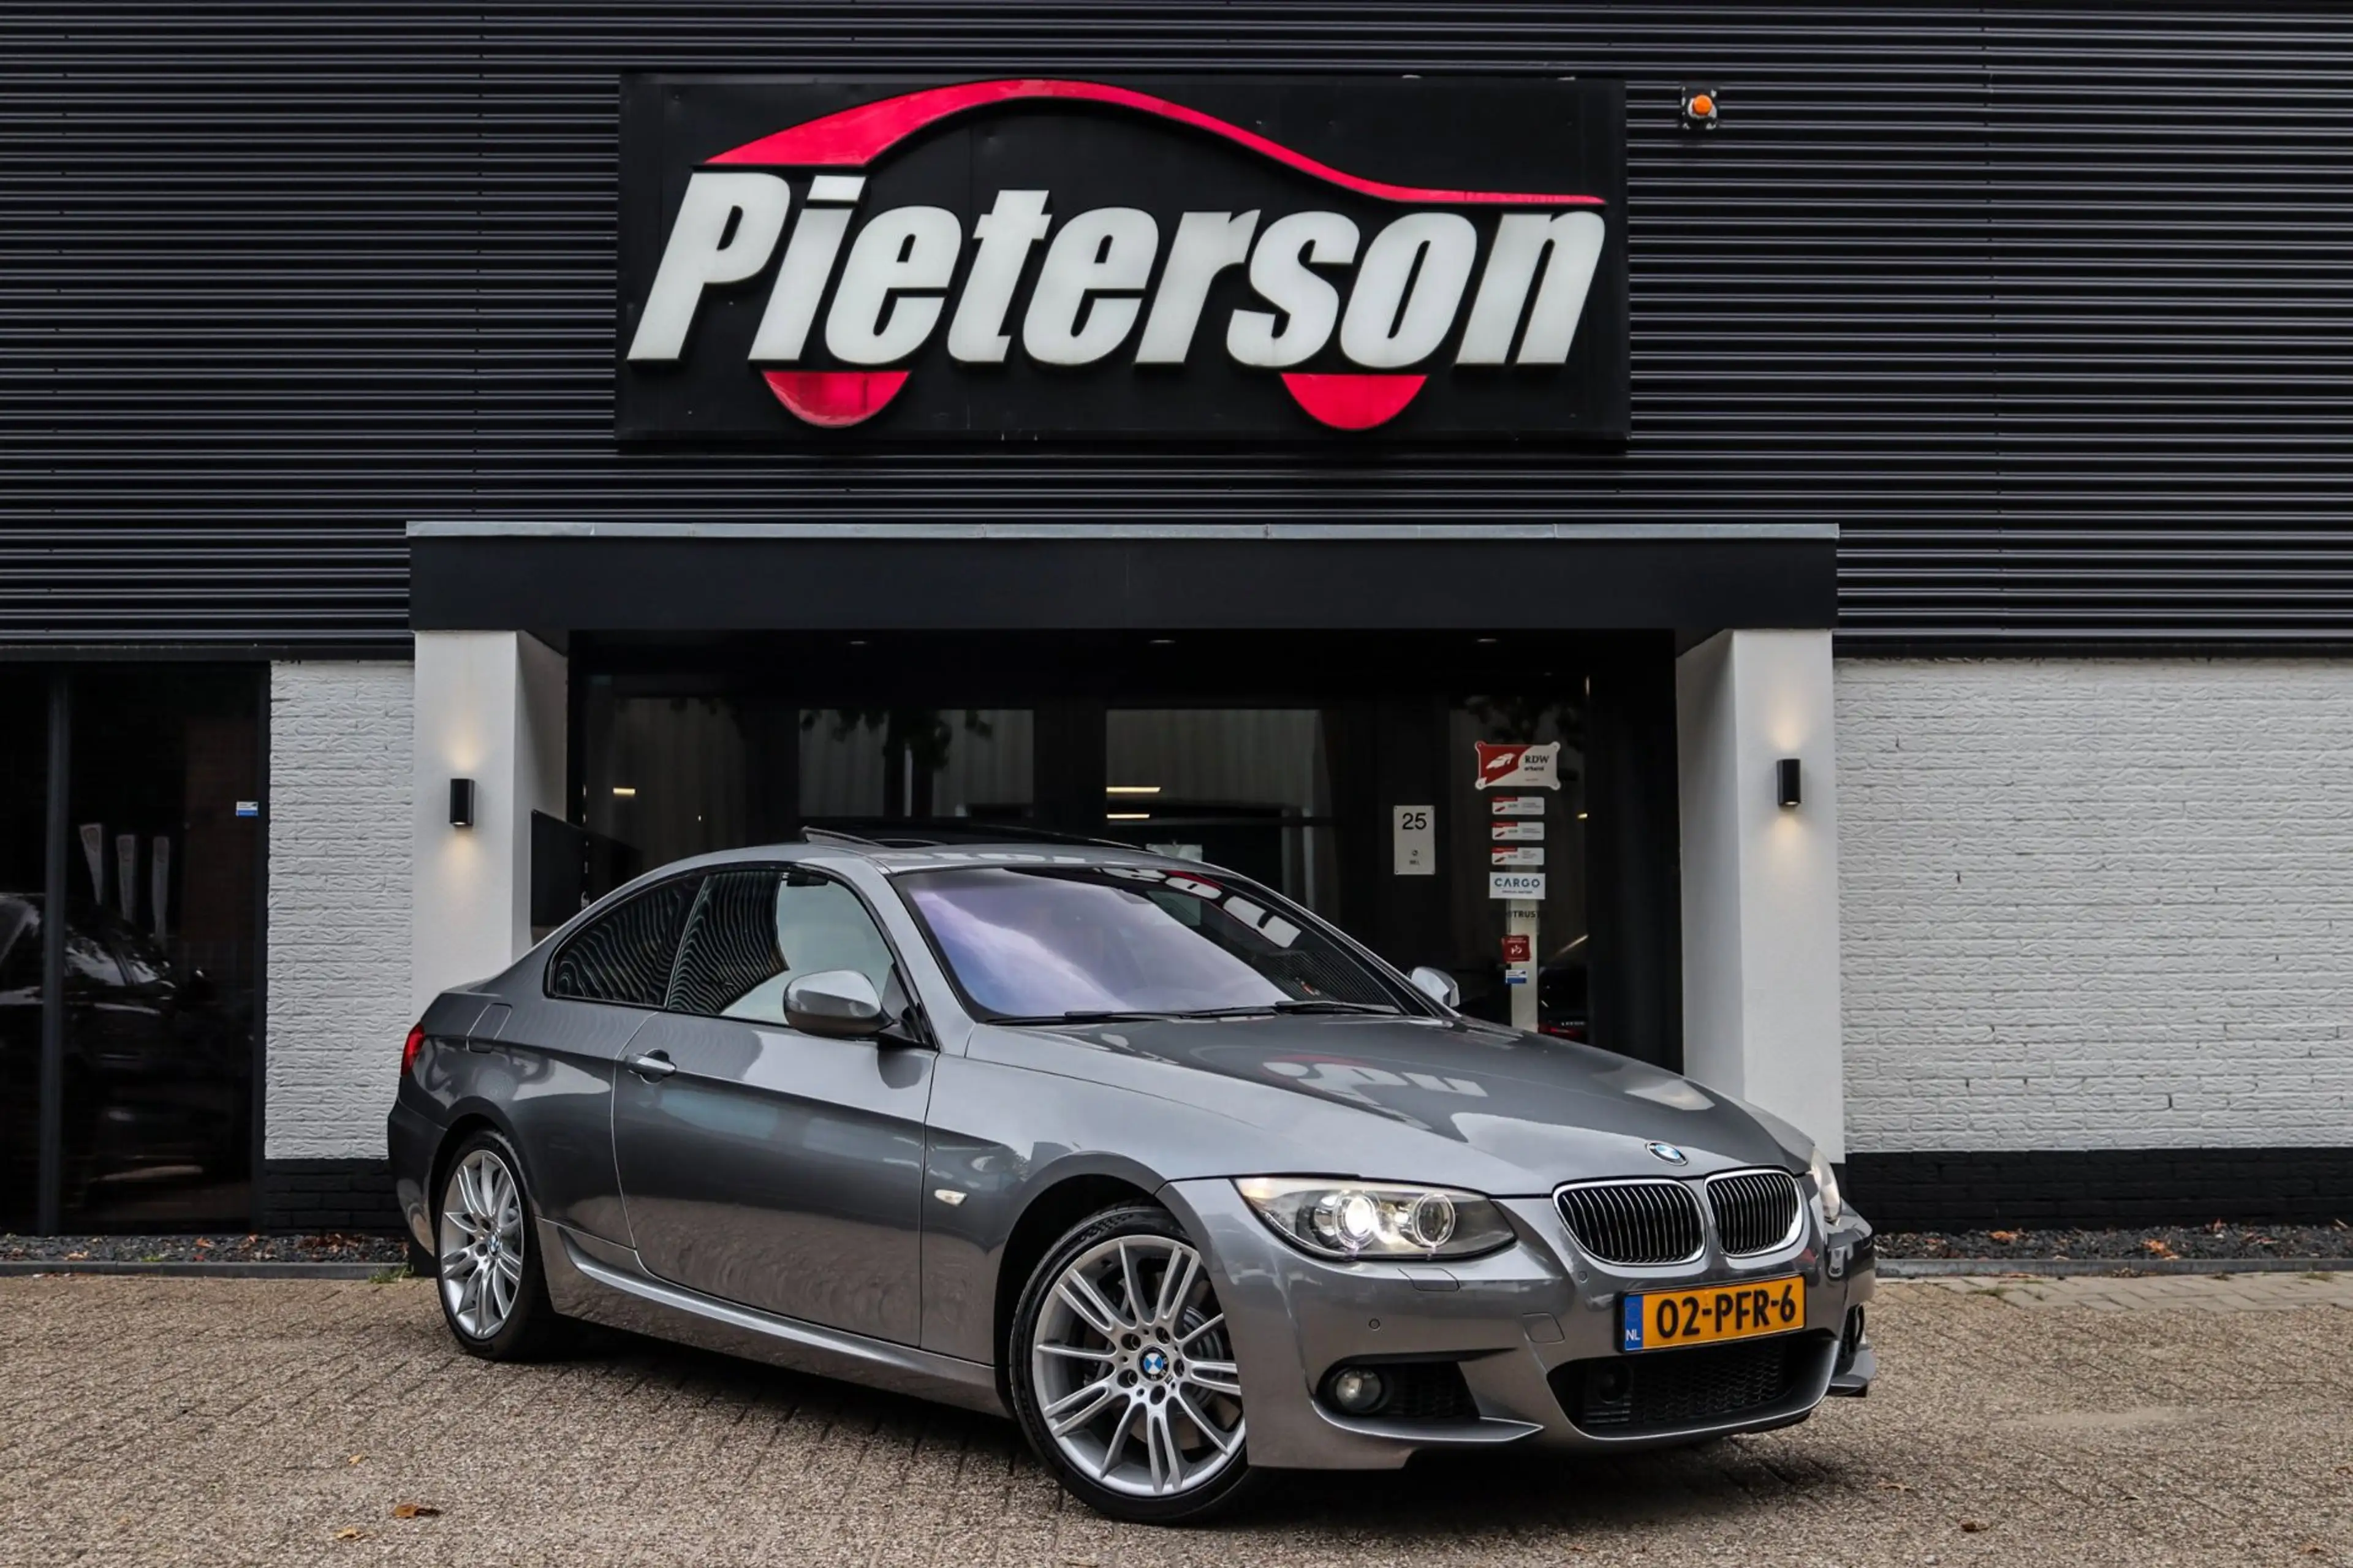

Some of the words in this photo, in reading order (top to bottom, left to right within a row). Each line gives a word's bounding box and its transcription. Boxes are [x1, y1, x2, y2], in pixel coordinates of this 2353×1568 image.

[626, 172, 1605, 367] Pieterson
[1525, 755, 1550, 763] RDW
[1403, 812, 1427, 830] 25
[1494, 877, 1540, 888] CARGO
[1656, 1284, 1796, 1339] 02-PFR-6
[1625, 1328, 1641, 1341] NL
